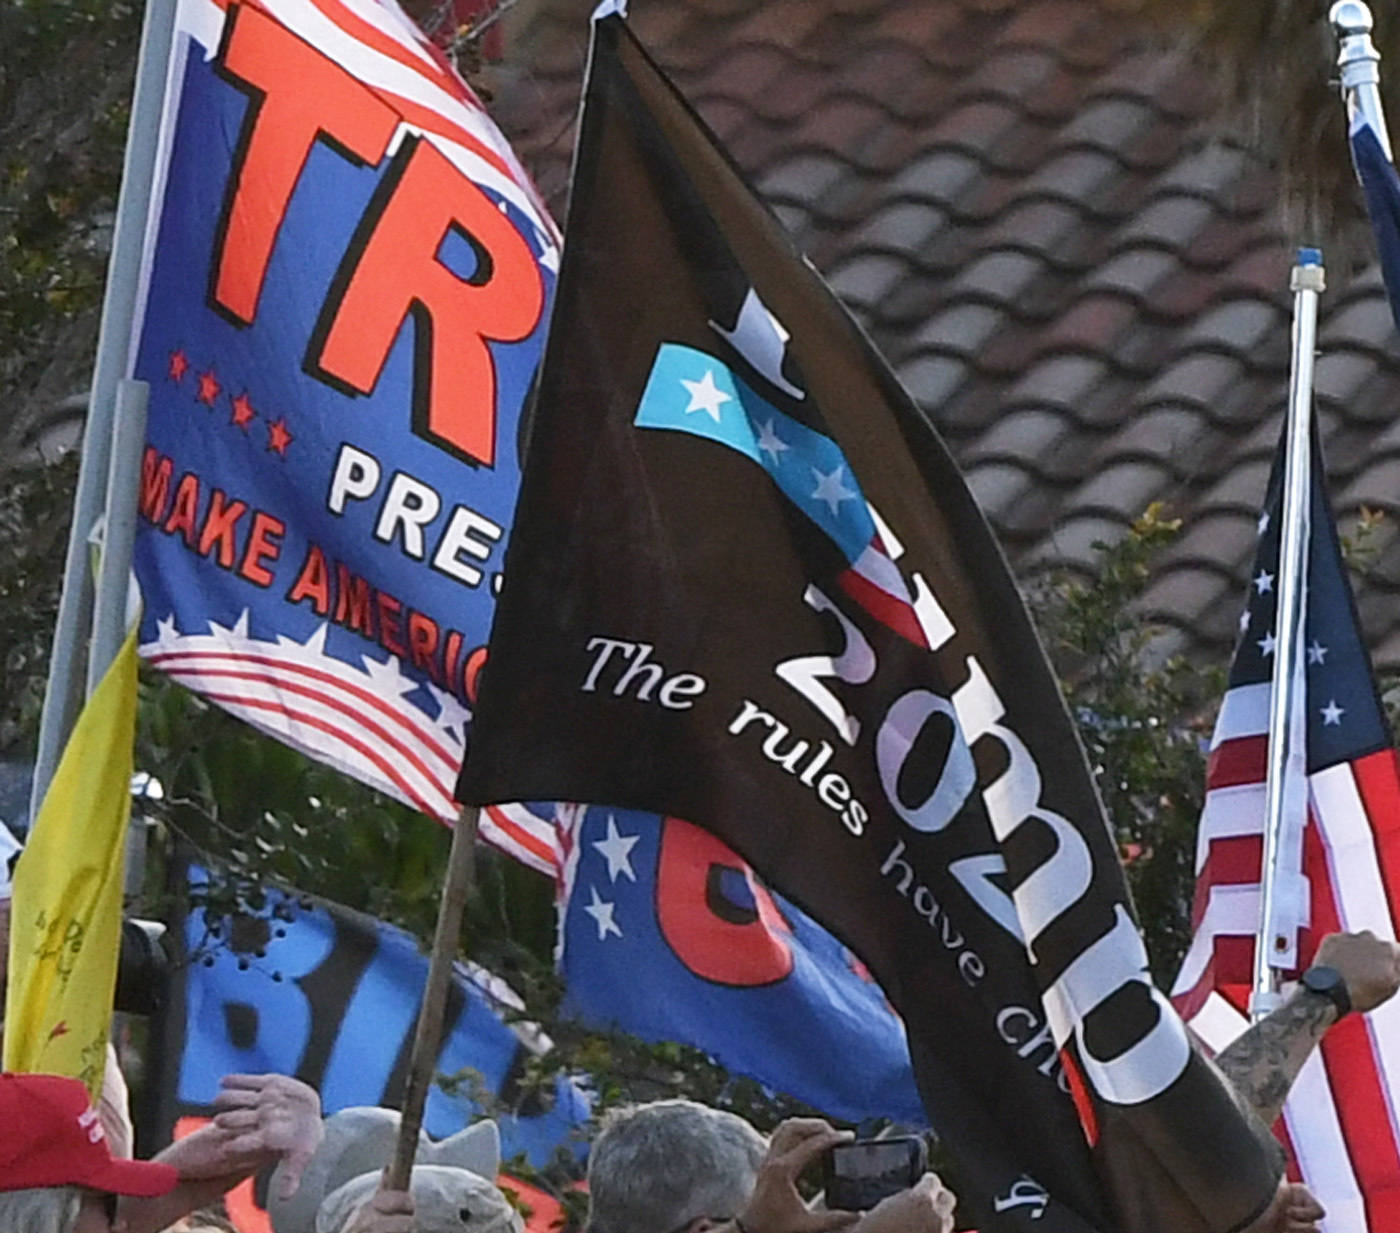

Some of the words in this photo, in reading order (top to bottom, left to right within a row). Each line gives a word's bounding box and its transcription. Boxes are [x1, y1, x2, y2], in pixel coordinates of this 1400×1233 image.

[139, 446, 287, 586] MAKE
[327, 442, 504, 592] PRE
[581, 636, 706, 711] The
[728, 700, 871, 838] rules
[879, 840, 986, 987] have
